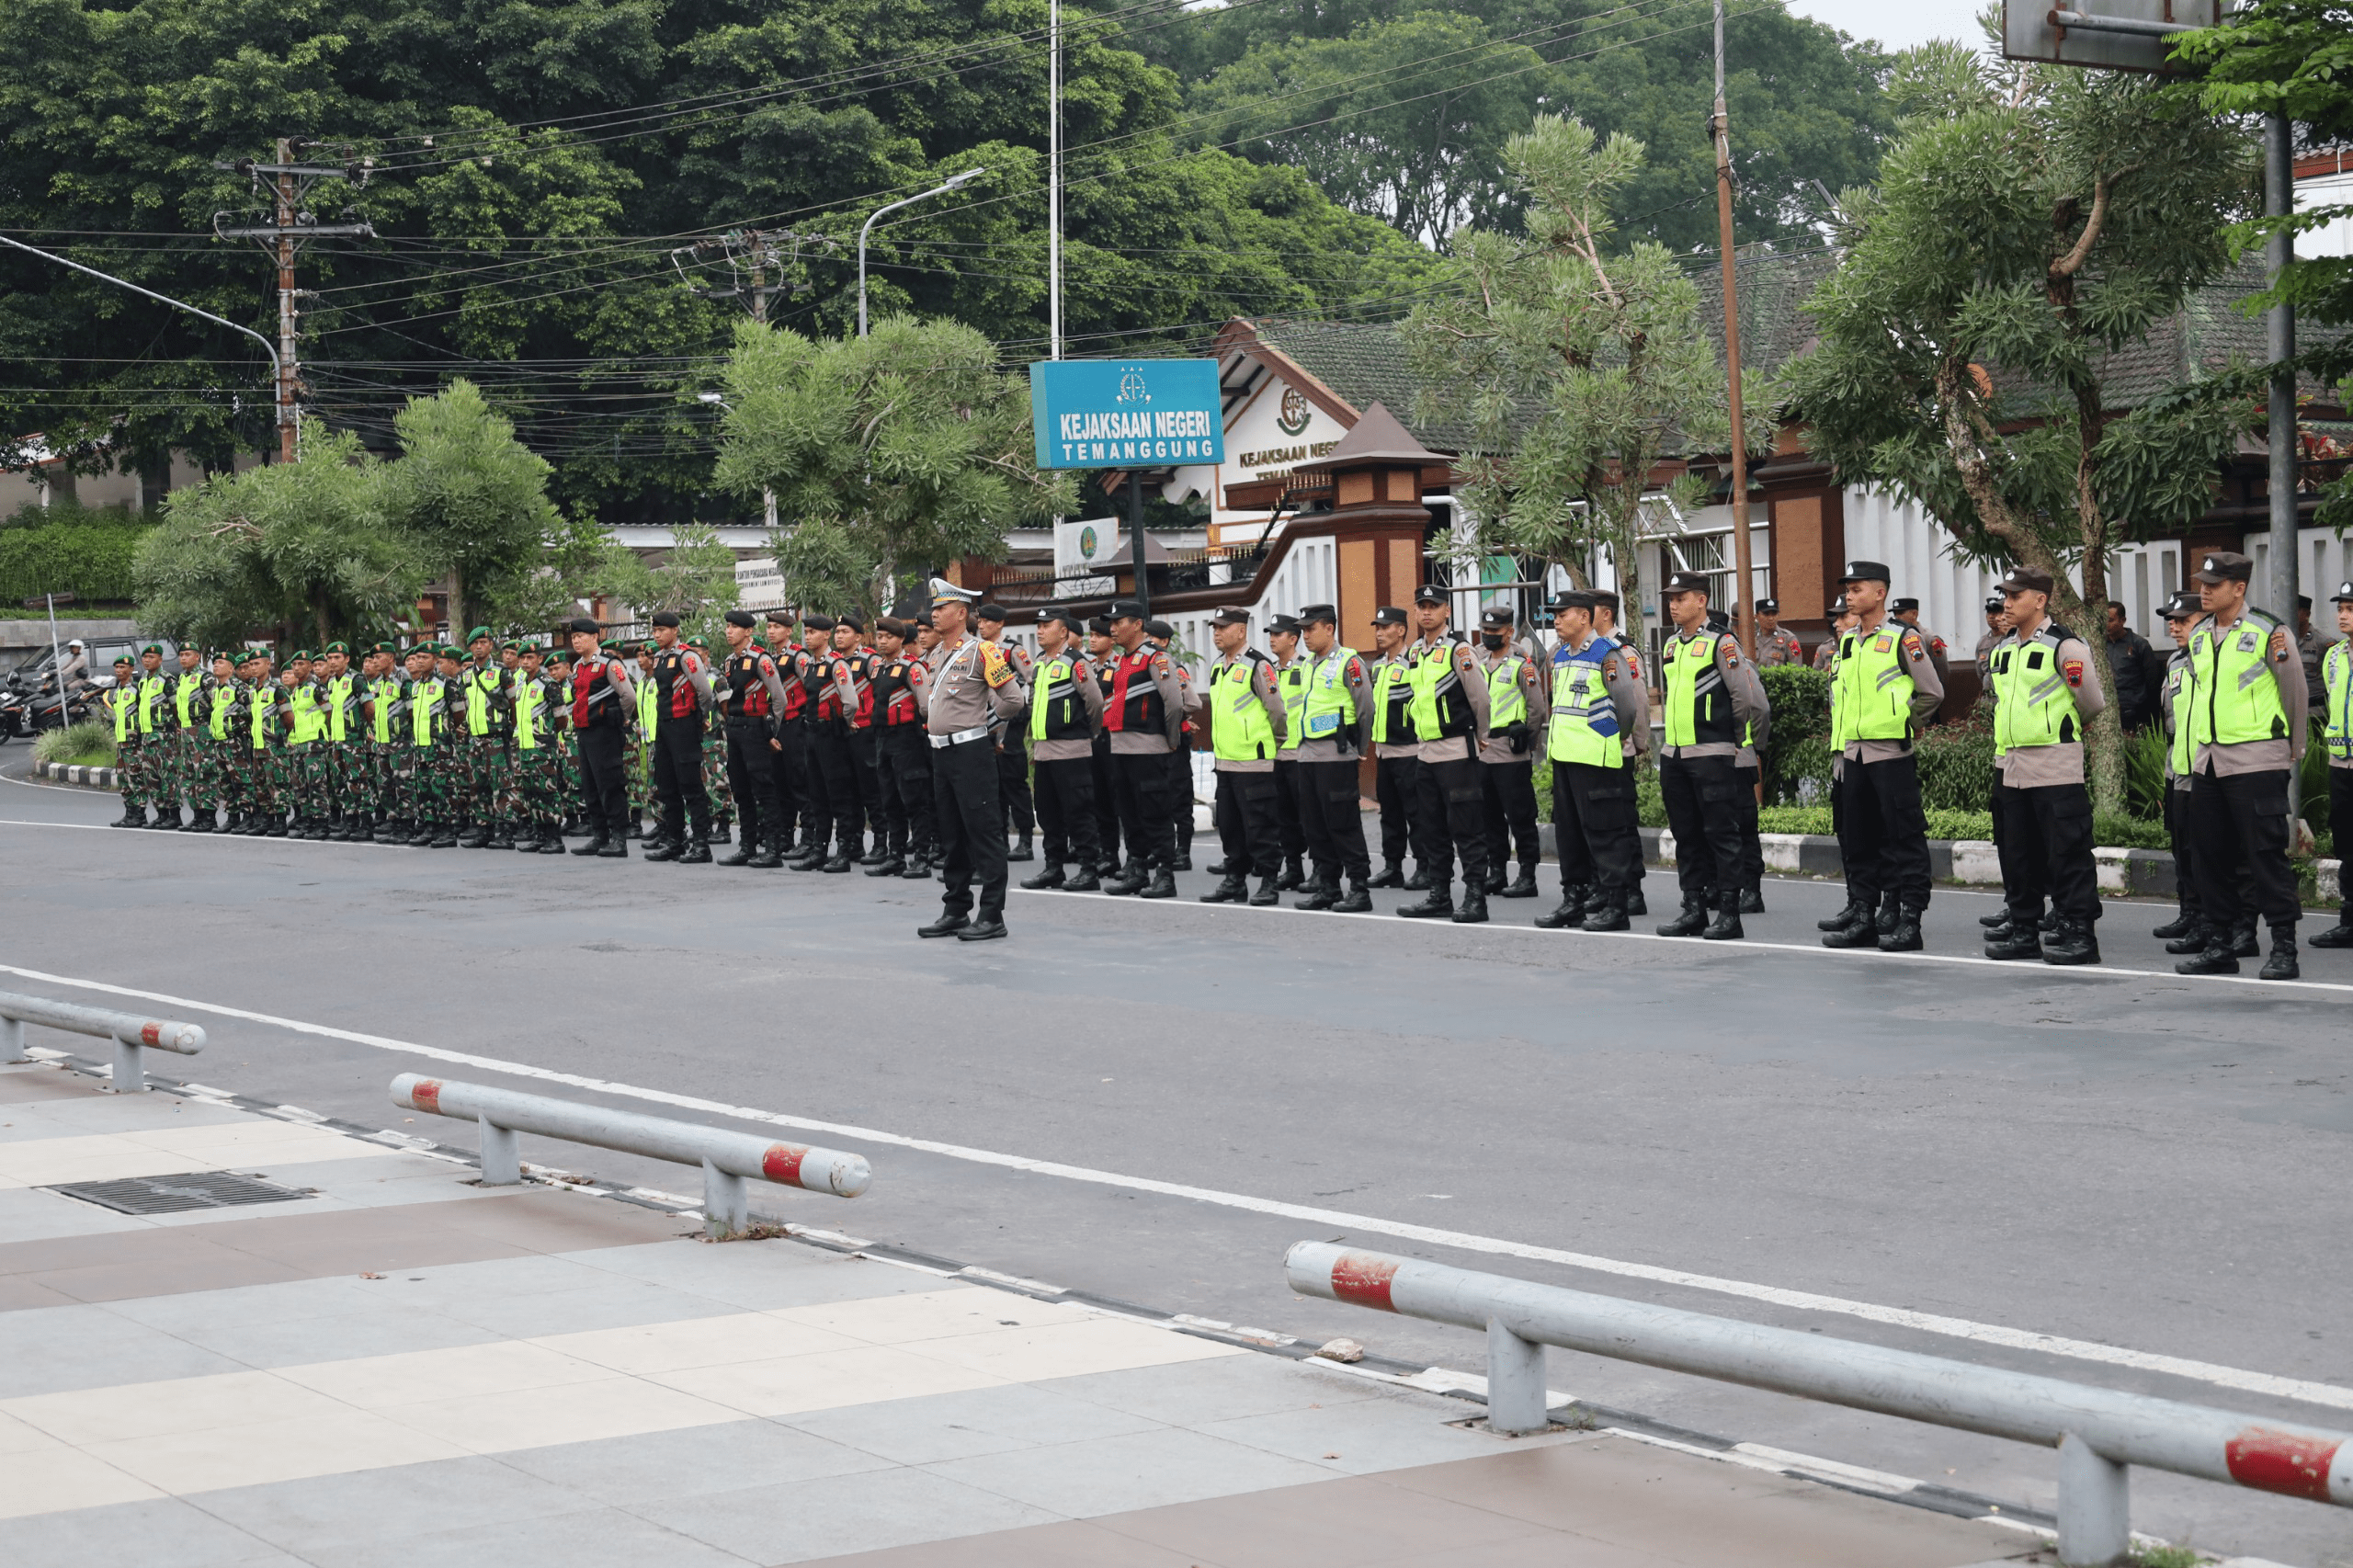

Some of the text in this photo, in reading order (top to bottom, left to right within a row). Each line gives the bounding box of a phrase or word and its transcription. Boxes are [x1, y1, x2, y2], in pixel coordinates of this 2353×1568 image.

[1060, 411, 1211, 440] KEJAKSAAN NEGERI
[1063, 440, 1212, 460] TEMANGGUNG
[1239, 445, 1307, 468] KEJAKSAAN
[1570, 684, 1589, 693] POLISI
